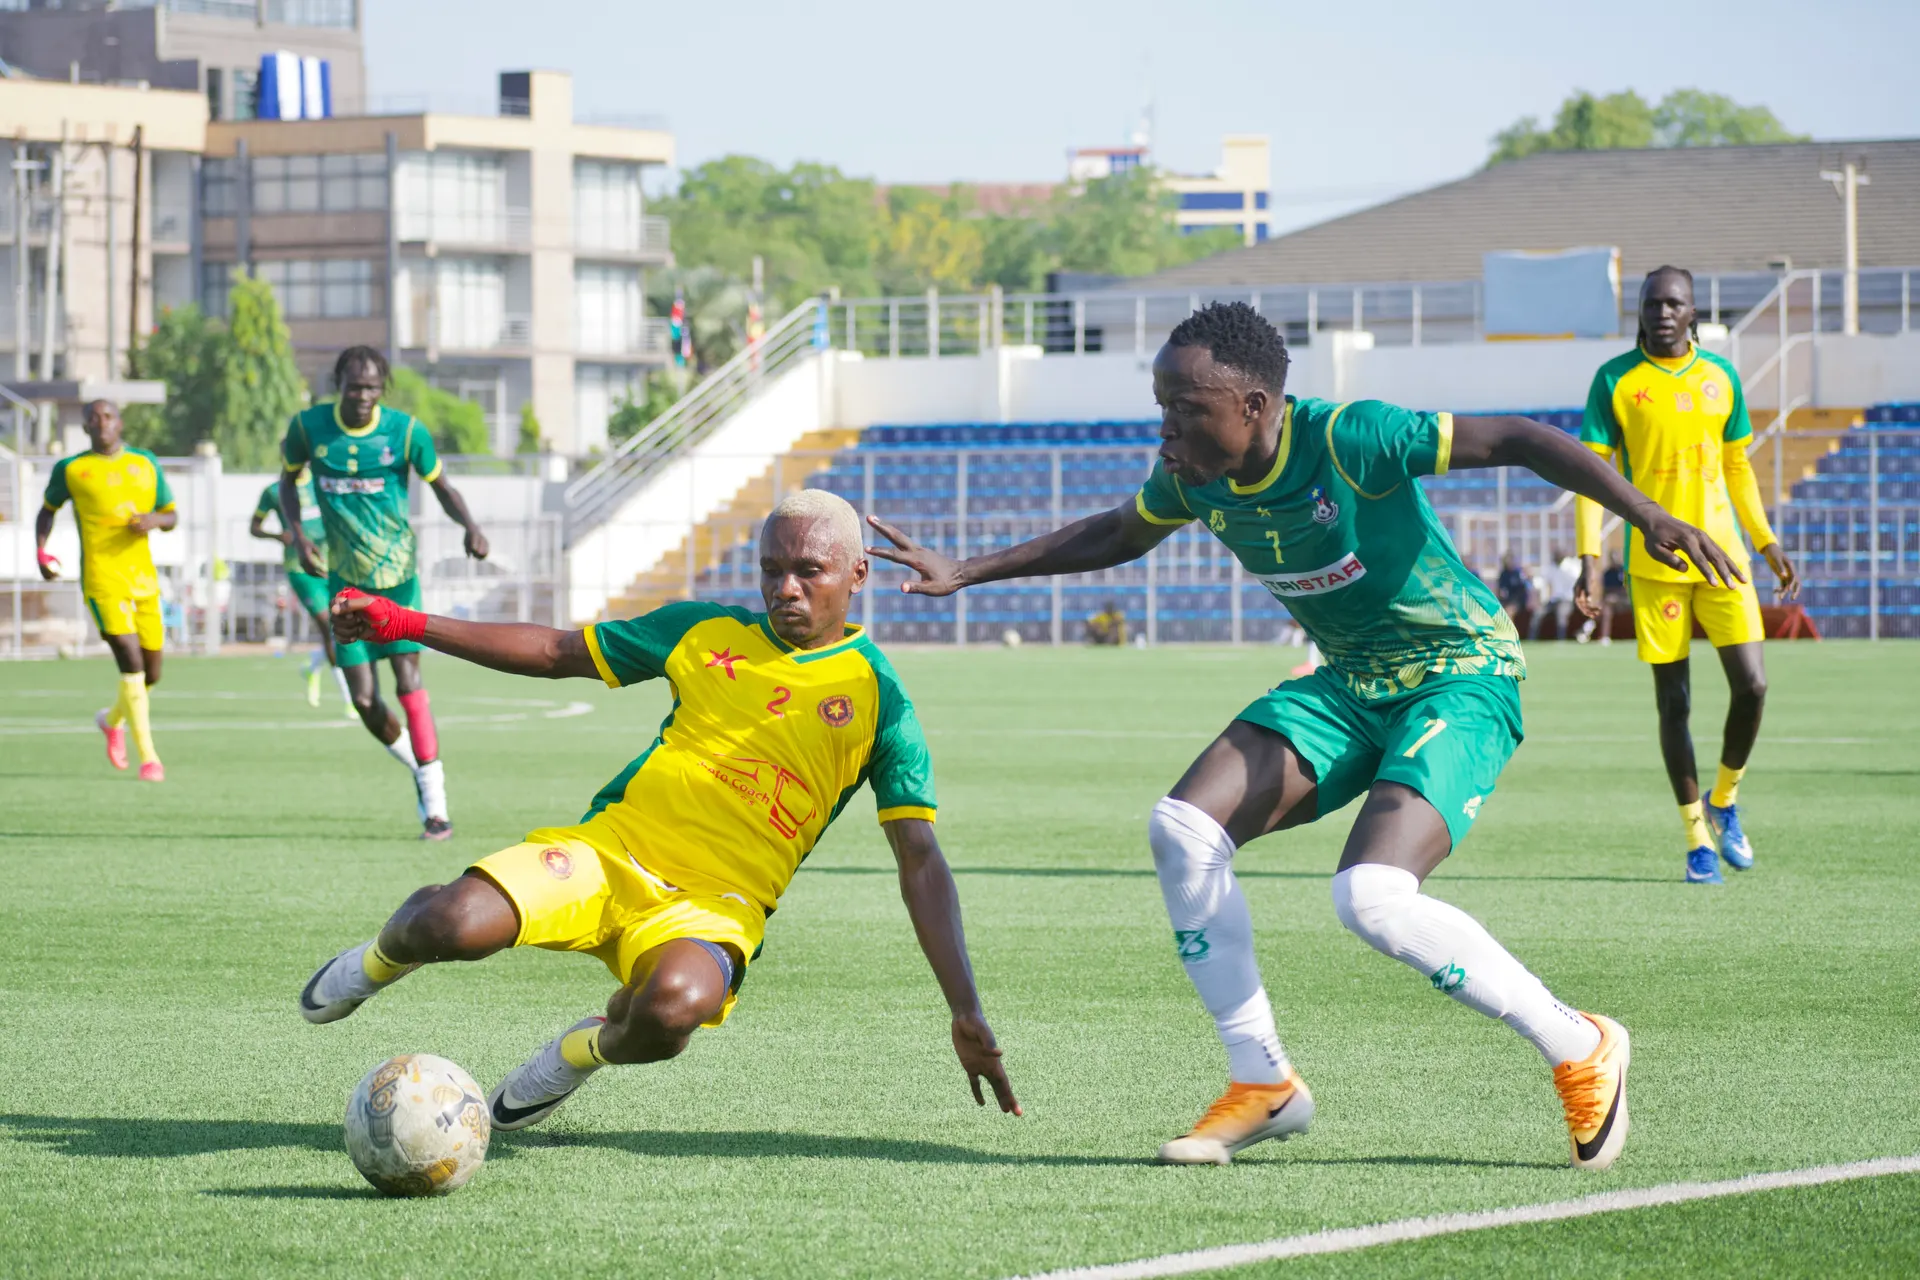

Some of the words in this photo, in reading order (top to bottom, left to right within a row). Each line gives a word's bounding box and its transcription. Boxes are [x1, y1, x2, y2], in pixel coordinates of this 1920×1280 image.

[1673, 392, 1694, 412] 18
[1264, 530, 1285, 564] 7
[766, 686, 791, 719] 2
[1402, 718, 1447, 758] 7
[731, 778, 770, 805] Coach
